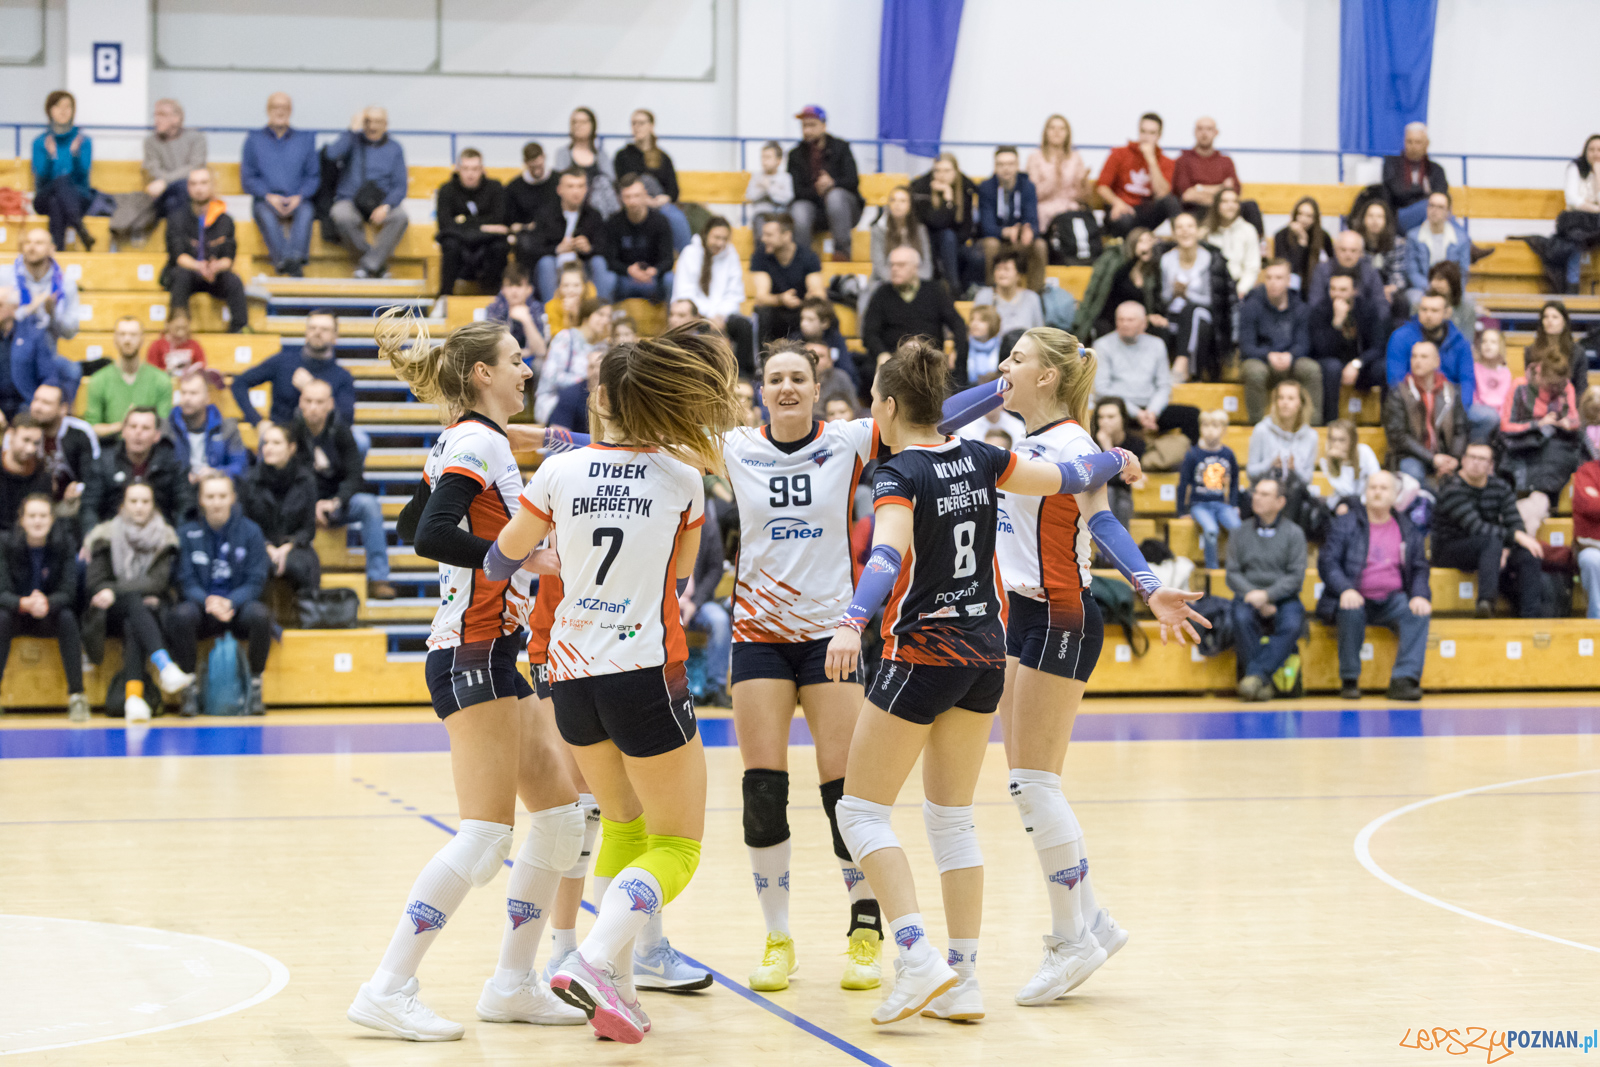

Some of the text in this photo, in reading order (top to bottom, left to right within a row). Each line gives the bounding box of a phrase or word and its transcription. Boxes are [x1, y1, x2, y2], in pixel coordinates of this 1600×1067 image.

[97, 47, 118, 79] B
[588, 462, 648, 479] DYBEK
[596, 484, 630, 496] ENEA
[769, 474, 812, 508] 99
[950, 480, 971, 496] ENEA
[572, 497, 653, 518] ENERGETYK
[937, 487, 990, 517] ENERGETYK
[771, 526, 824, 540] Enea
[592, 527, 624, 586] 7
[953, 520, 977, 579] 8
[462, 669, 483, 687] 11
[683, 699, 693, 719] 7
